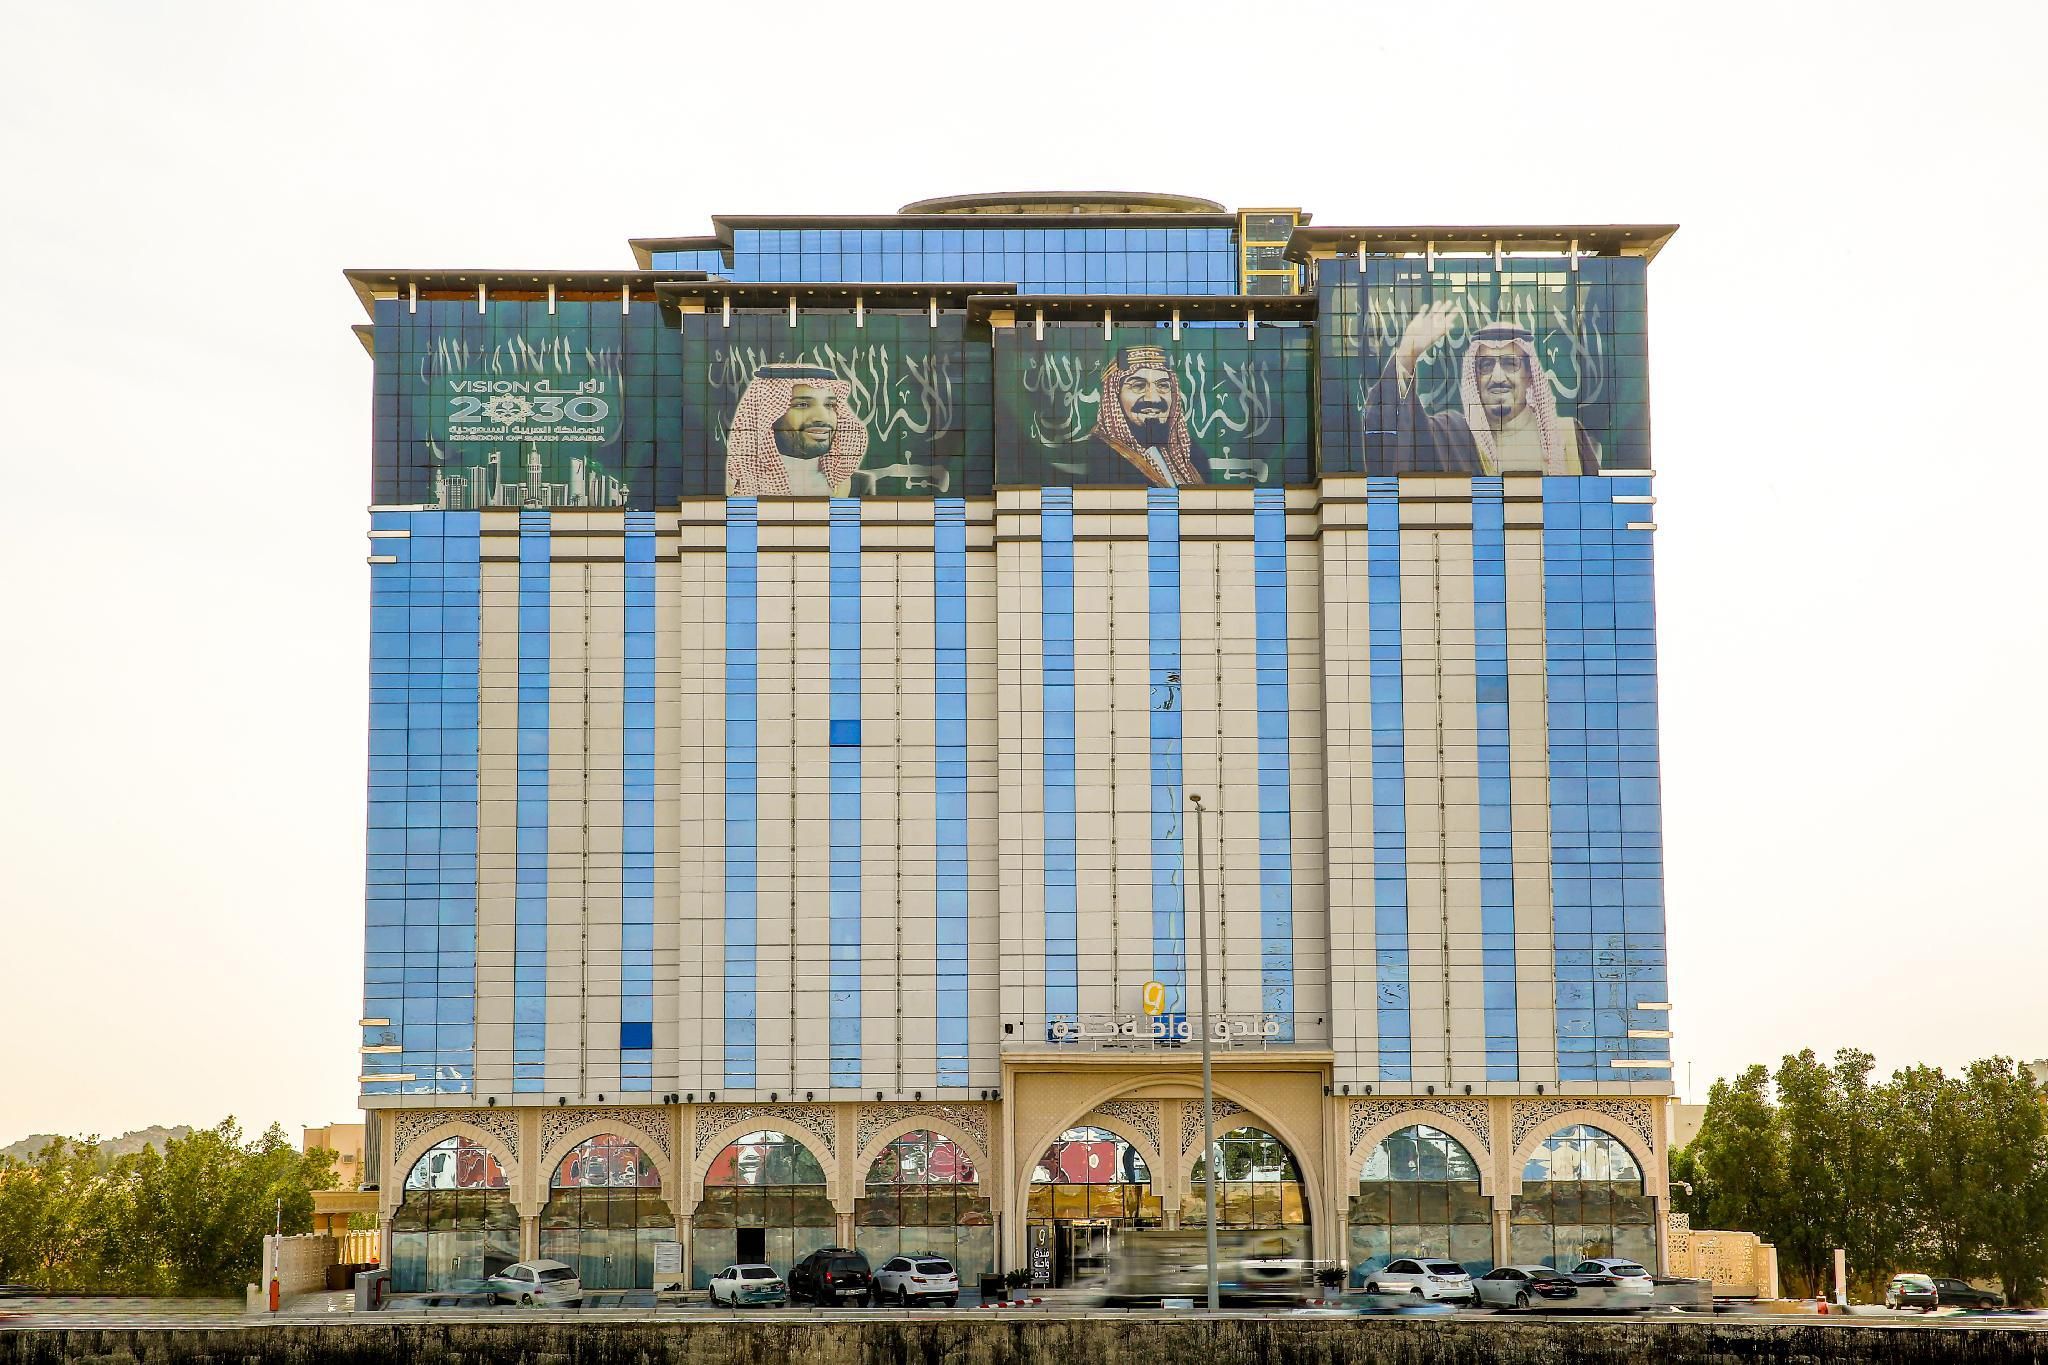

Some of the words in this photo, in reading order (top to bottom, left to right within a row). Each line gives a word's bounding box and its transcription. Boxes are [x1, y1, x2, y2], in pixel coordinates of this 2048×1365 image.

[449, 380, 530, 394] VISION
[533, 378, 605, 395] رؤية
[448, 425, 509, 435] السعودية
[511, 425, 552, 435] العربية
[553, 425, 605, 434] المملكة
[449, 434, 504, 442] KINGDOM
[1033, 1247, 1050, 1259] فندق
